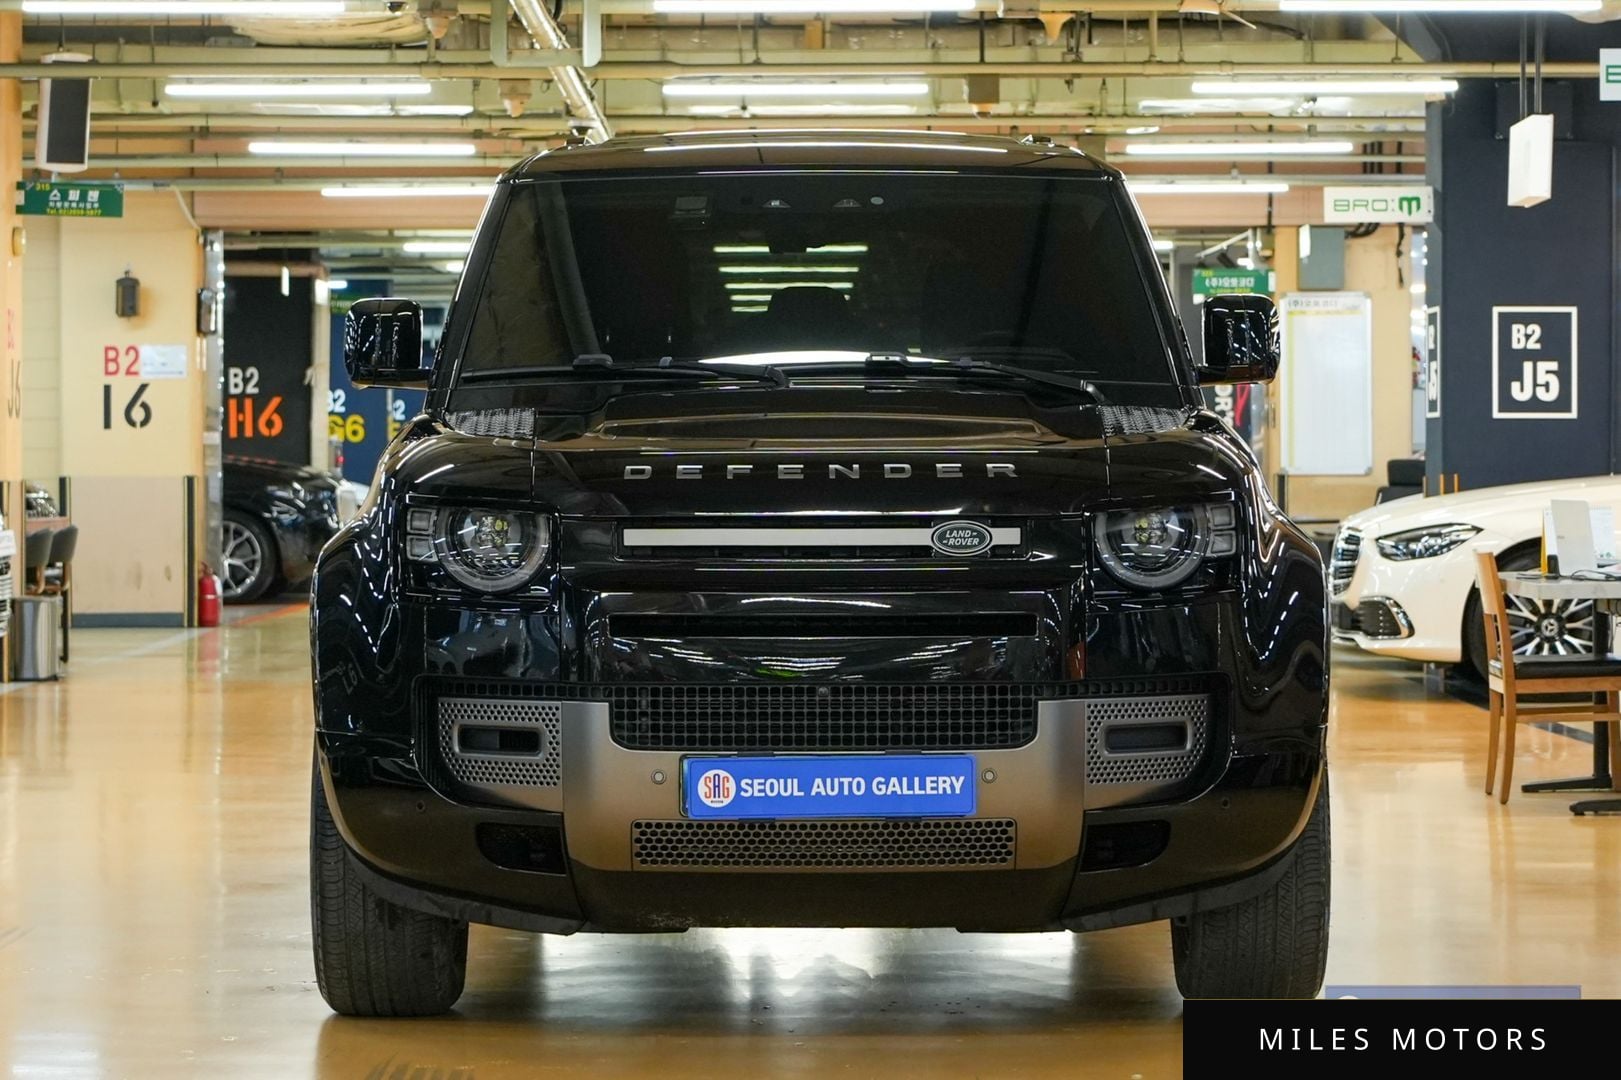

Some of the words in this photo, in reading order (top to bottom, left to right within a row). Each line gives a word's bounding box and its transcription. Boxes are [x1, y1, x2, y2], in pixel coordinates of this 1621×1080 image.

[1511, 323, 1542, 349] B2
[104, 345, 140, 376] B2
[228, 367, 260, 394] B2
[1511, 361, 1560, 402] J5
[228, 396, 283, 438] H6
[624, 463, 1019, 480] DEFENDER
[704, 773, 730, 800] SAG
[740, 777, 805, 797] SEOUL
[810, 776, 866, 796] AUTO
[871, 775, 965, 795] GALLERY
